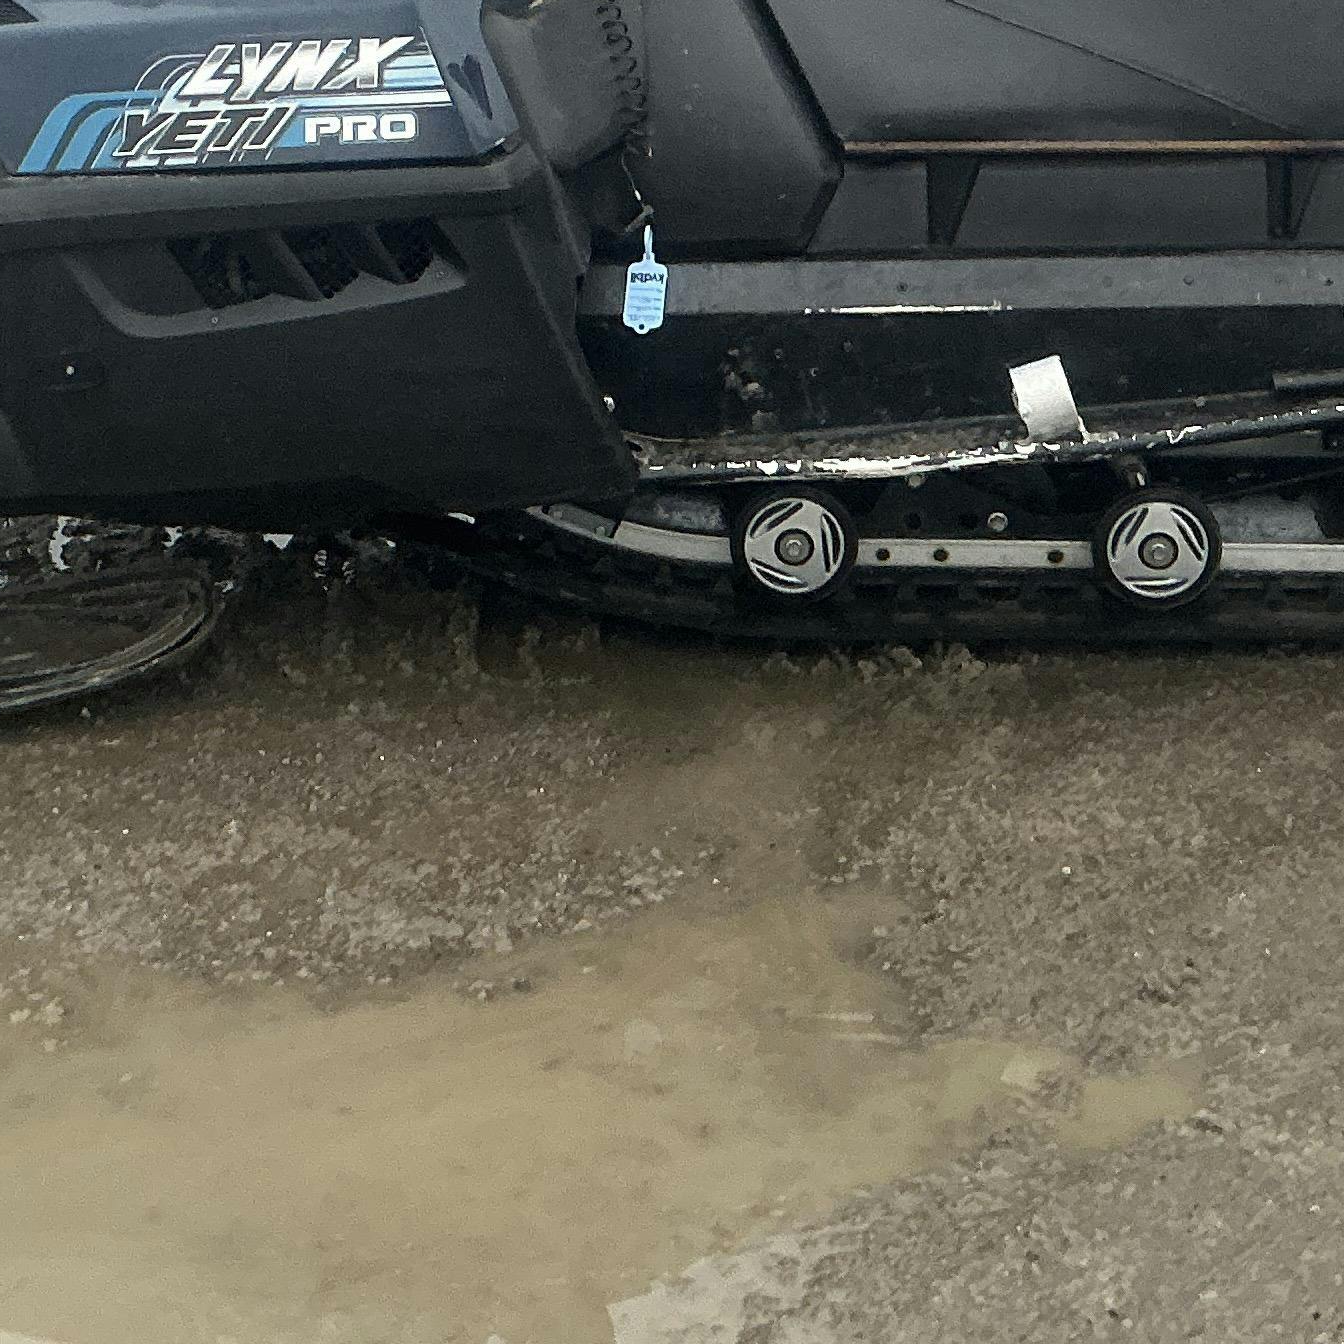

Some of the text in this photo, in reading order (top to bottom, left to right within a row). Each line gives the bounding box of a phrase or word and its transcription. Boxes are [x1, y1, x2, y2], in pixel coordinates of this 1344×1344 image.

[177, 35, 415, 102] LYNX
[112, 103, 420, 156] YETI PRO
